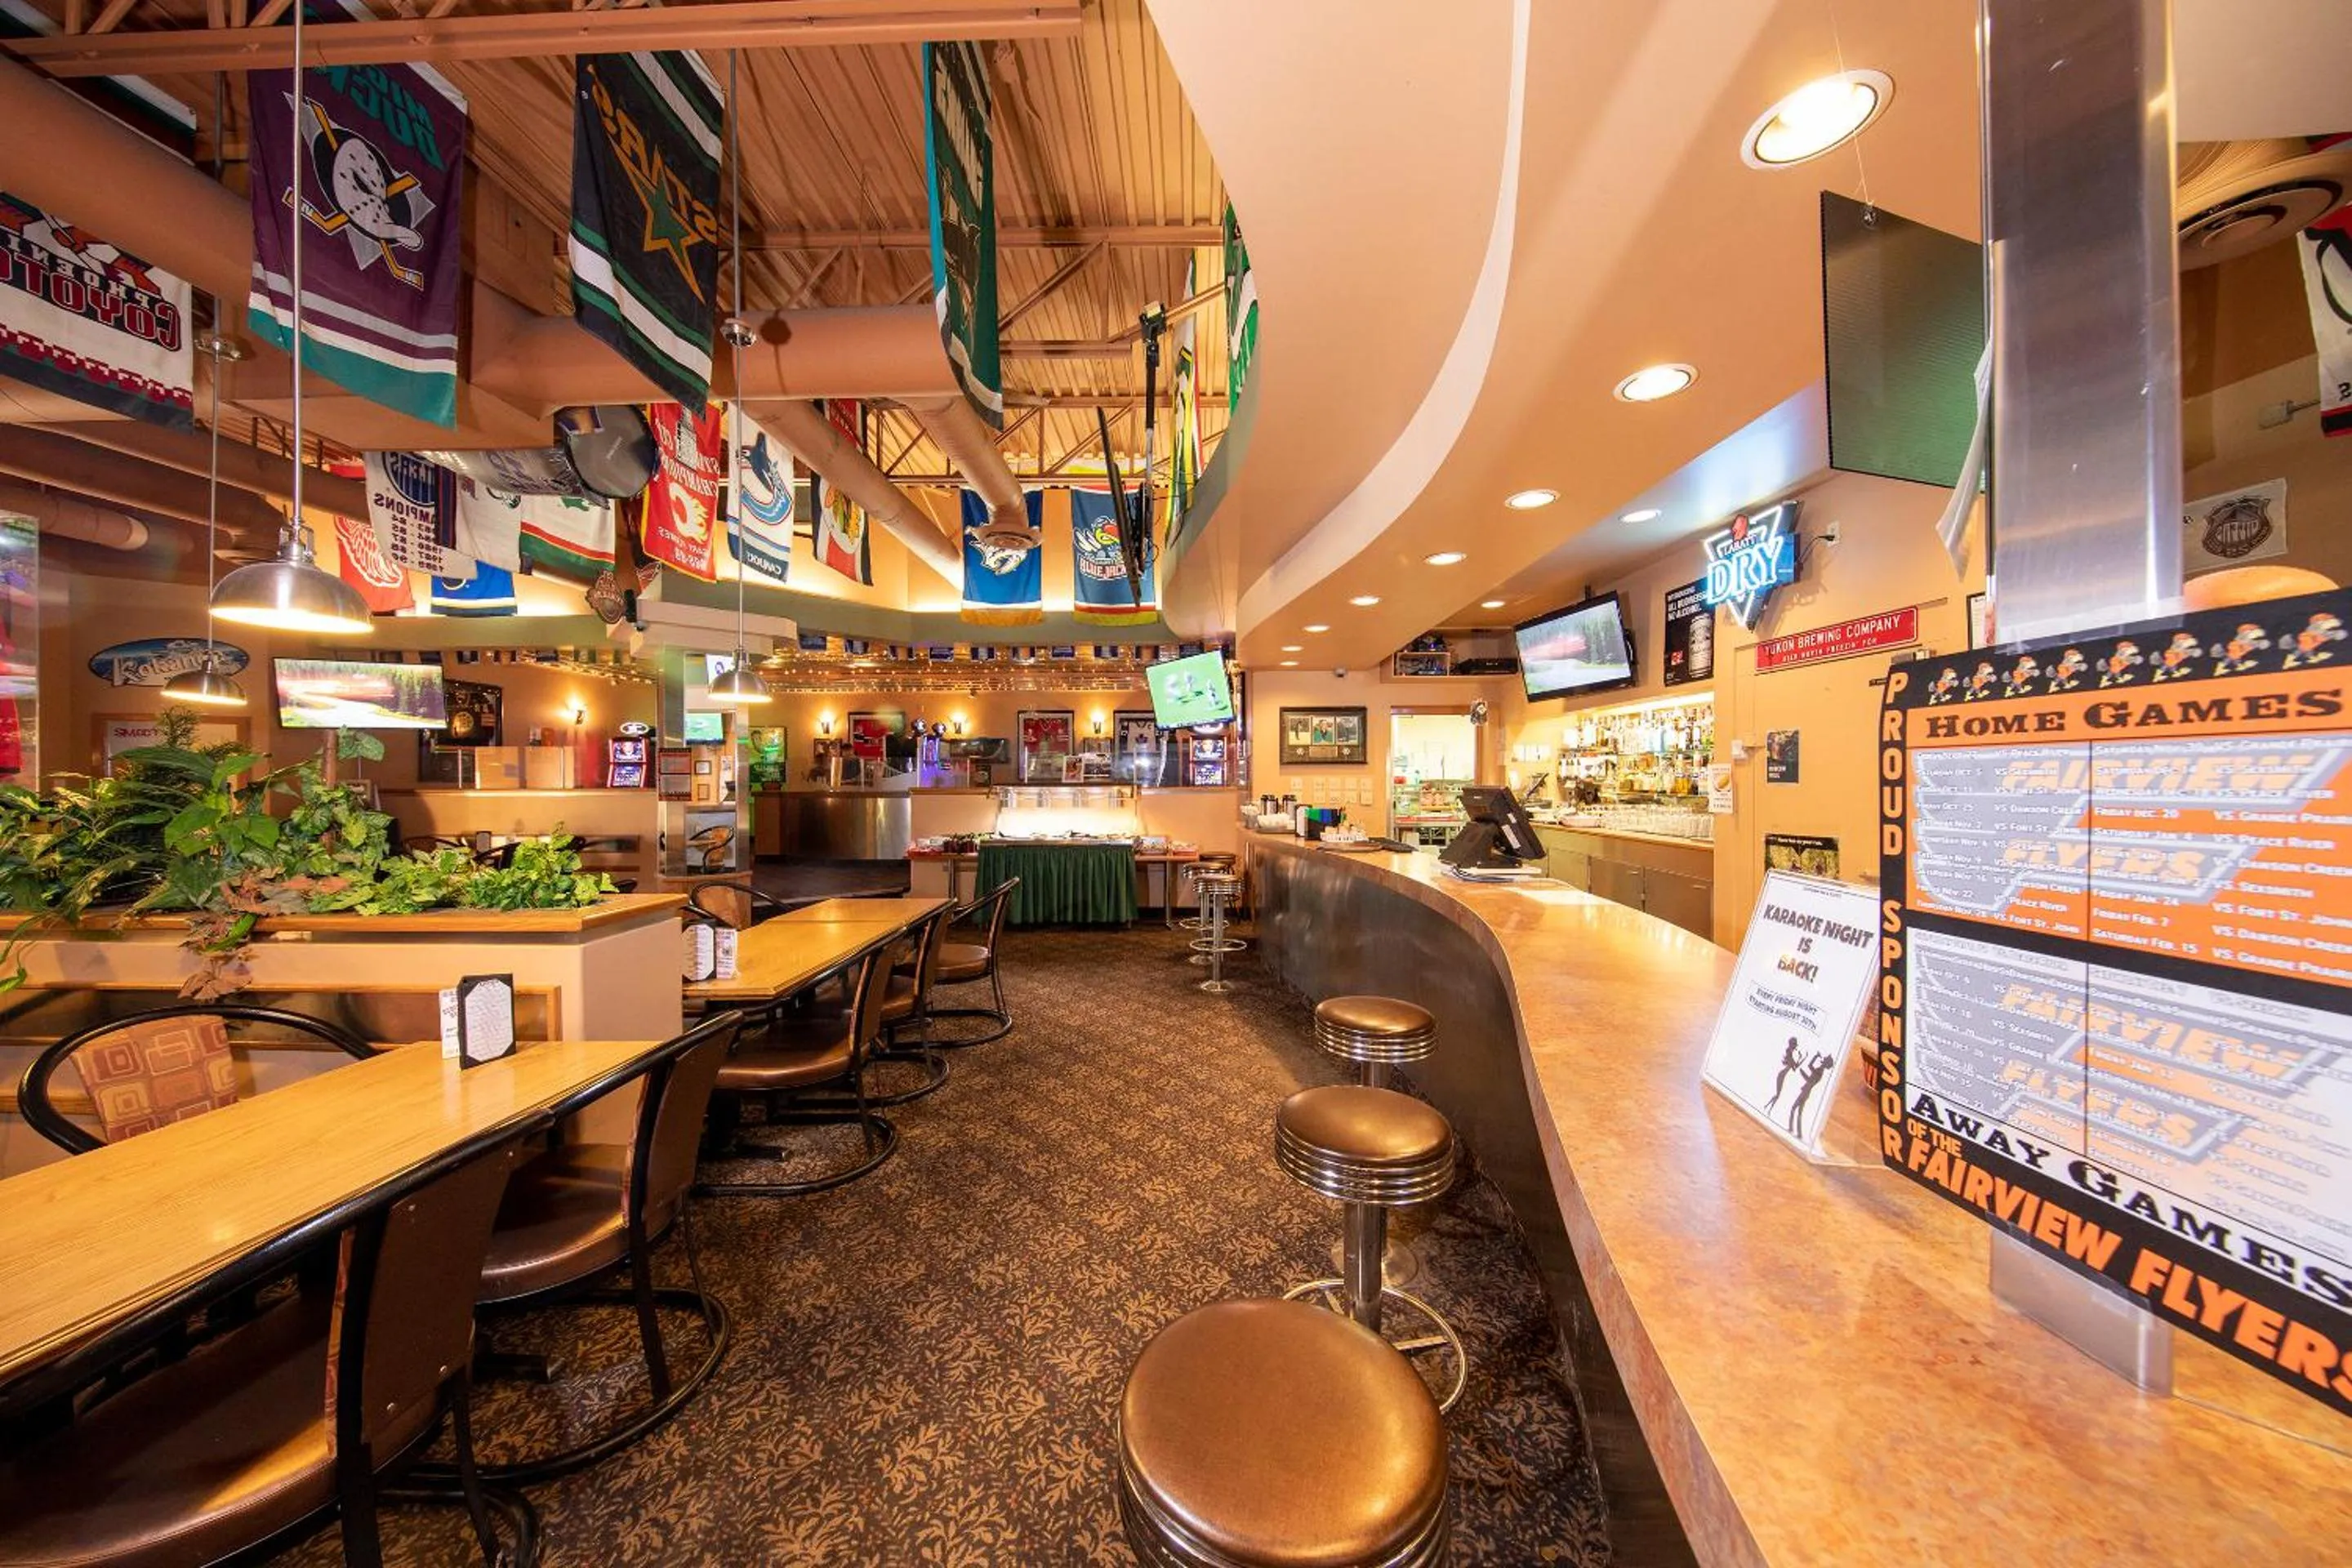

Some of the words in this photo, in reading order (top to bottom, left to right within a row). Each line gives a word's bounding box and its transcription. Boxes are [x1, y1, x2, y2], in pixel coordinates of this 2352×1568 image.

[1707, 536, 1784, 604] DRY
[1797, 628, 1842, 648] BREWING
[1846, 614, 1901, 637] COMPANY
[1926, 710, 2066, 738] HOME
[2083, 689, 2343, 729] GAMES
[1882, 671, 1909, 856] PROUD
[1763, 904, 1824, 934] KARAOKE
[1777, 954, 1820, 983] BACK!
[1797, 937, 1813, 954] IS
[1881, 899, 1904, 1163] SPONSOR
[1907, 1116, 1928, 1141] OF
[1930, 1127, 1962, 1158] THE
[1908, 1138, 2123, 1272] FAIRVIEW
[1911, 1093, 2052, 1169] AWAY
[2068, 1160, 2352, 1307] GAMES
